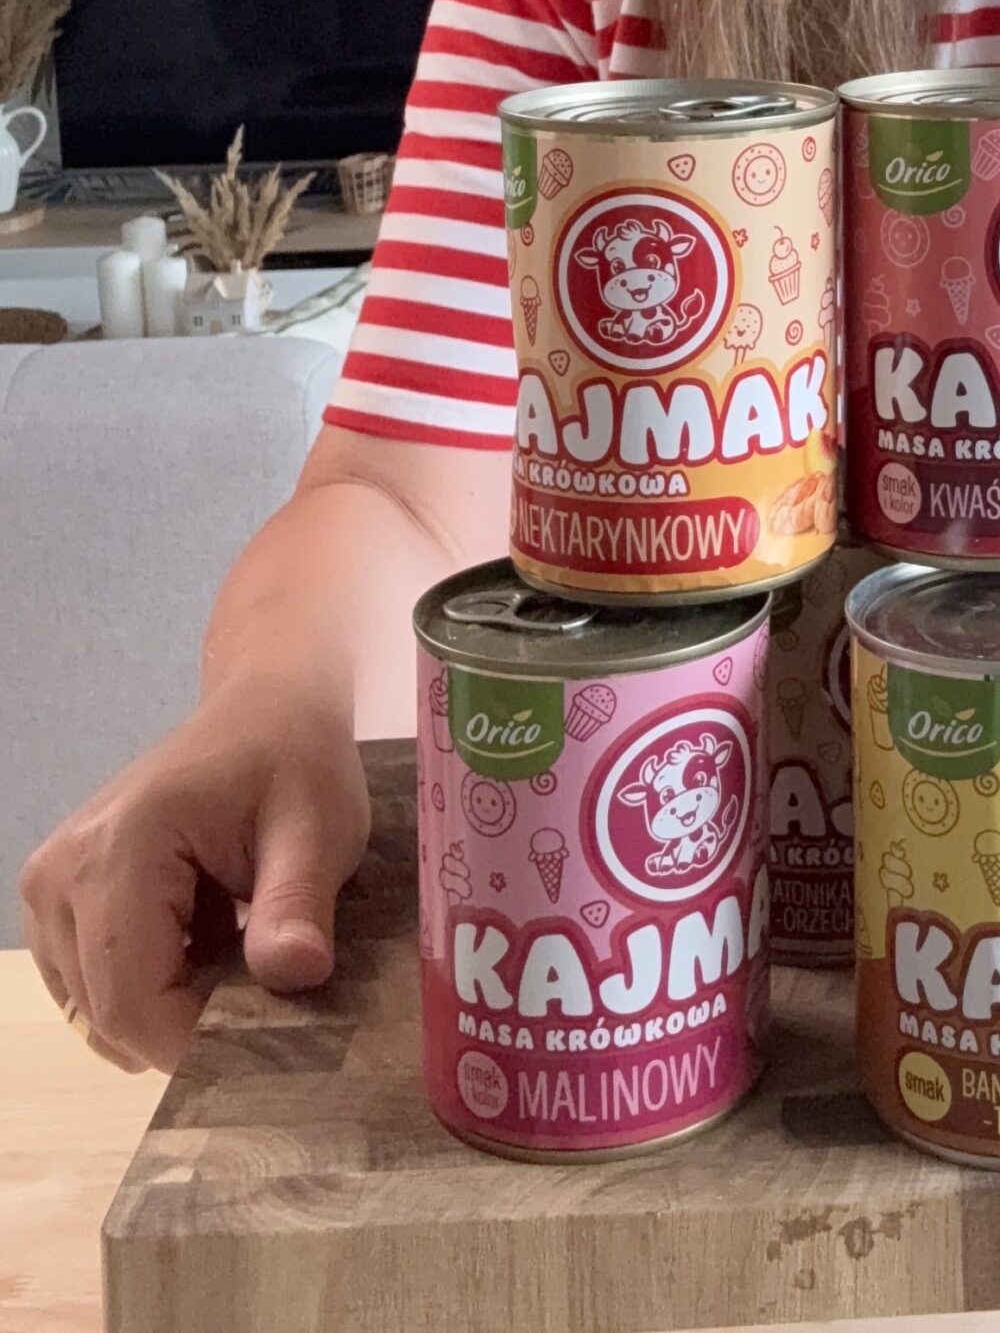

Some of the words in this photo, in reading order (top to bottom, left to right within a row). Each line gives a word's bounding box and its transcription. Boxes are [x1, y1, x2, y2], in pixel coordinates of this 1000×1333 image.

[885, 156, 952, 184] Orico
[877, 429, 945, 459] MASA
[529, 459, 688, 495] KRÓWKOWA
[882, 474, 916, 497] smak
[519, 497, 746, 564] NEKTARYNKOWY
[466, 712, 541, 745] Orico
[908, 710, 983, 745] Orico
[458, 1010, 535, 1051] MASA
[545, 992, 727, 1052] KRÓWKOWA
[899, 1011, 979, 1053] MASA
[517, 1035, 722, 1122] MALINOWY
[905, 1069, 946, 1104] smak
